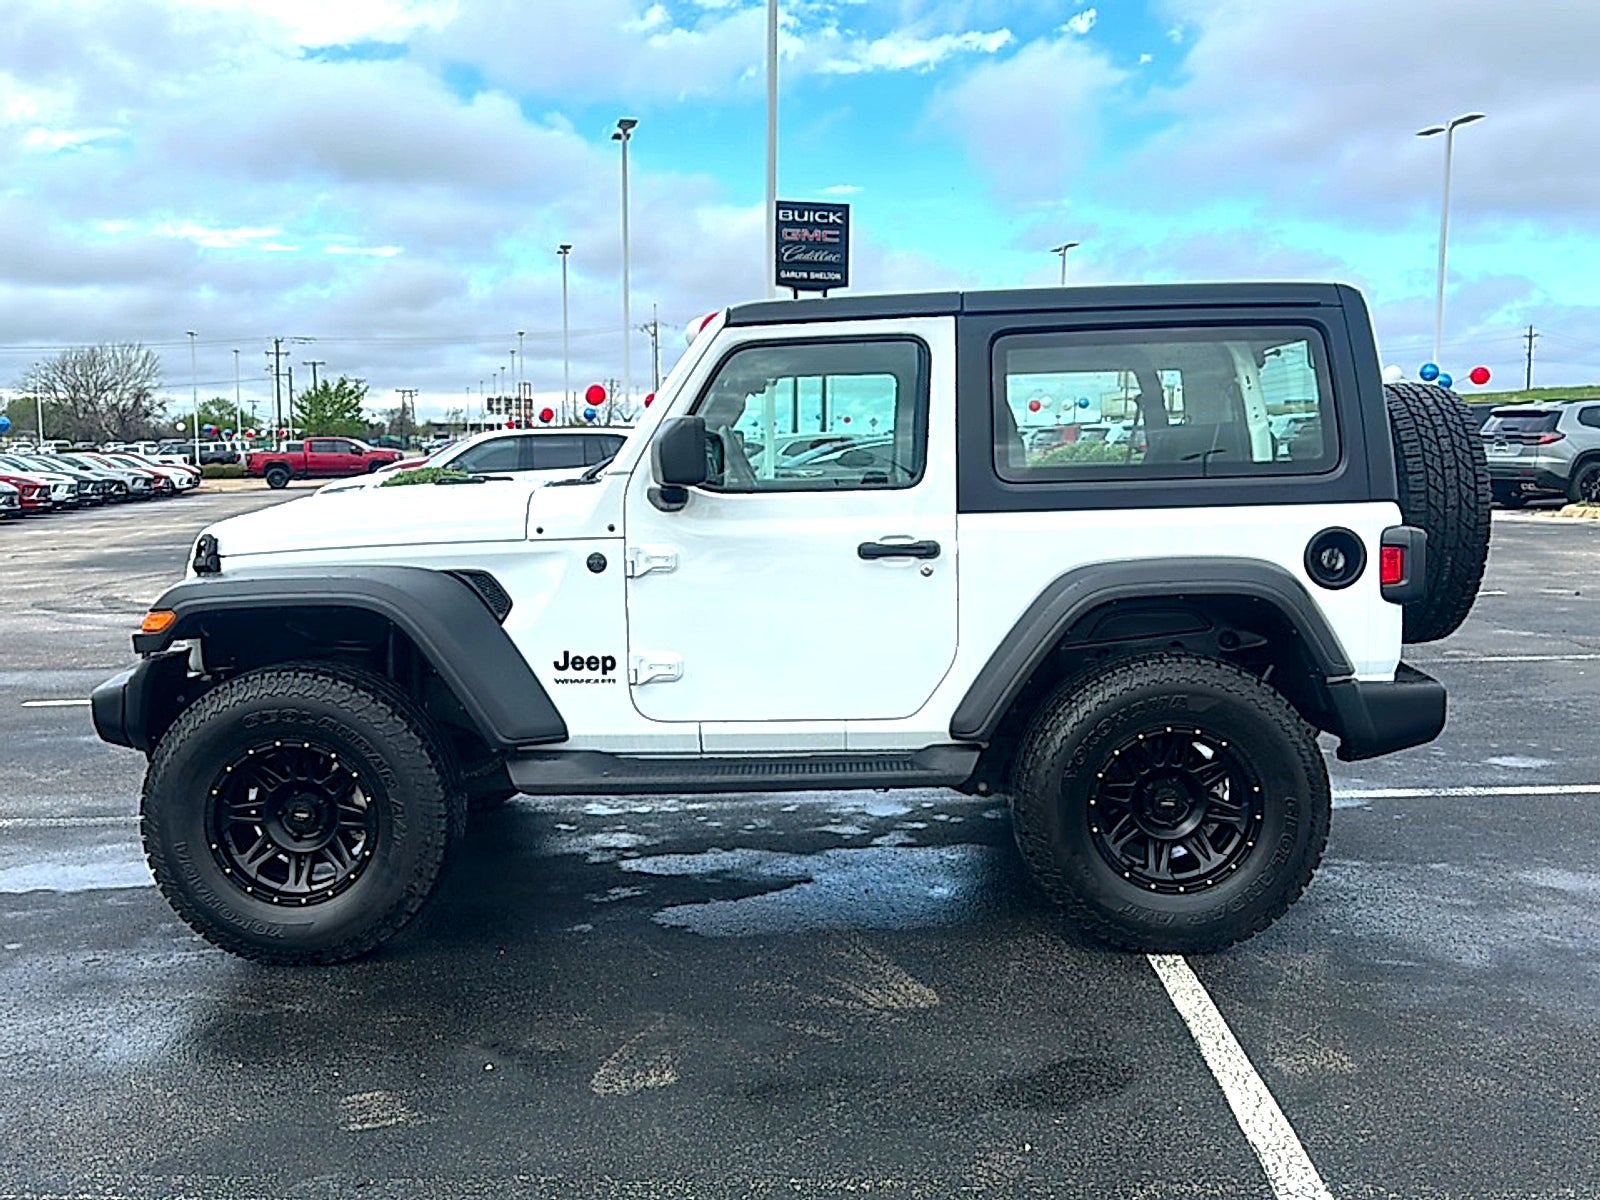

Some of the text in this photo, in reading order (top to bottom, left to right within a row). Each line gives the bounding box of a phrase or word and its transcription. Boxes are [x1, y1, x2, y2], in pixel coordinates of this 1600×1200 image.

[779, 209, 844, 224] BUICK
[781, 228, 840, 243] GMC
[781, 244, 842, 263] Cadillac
[553, 650, 617, 676] Jeep
